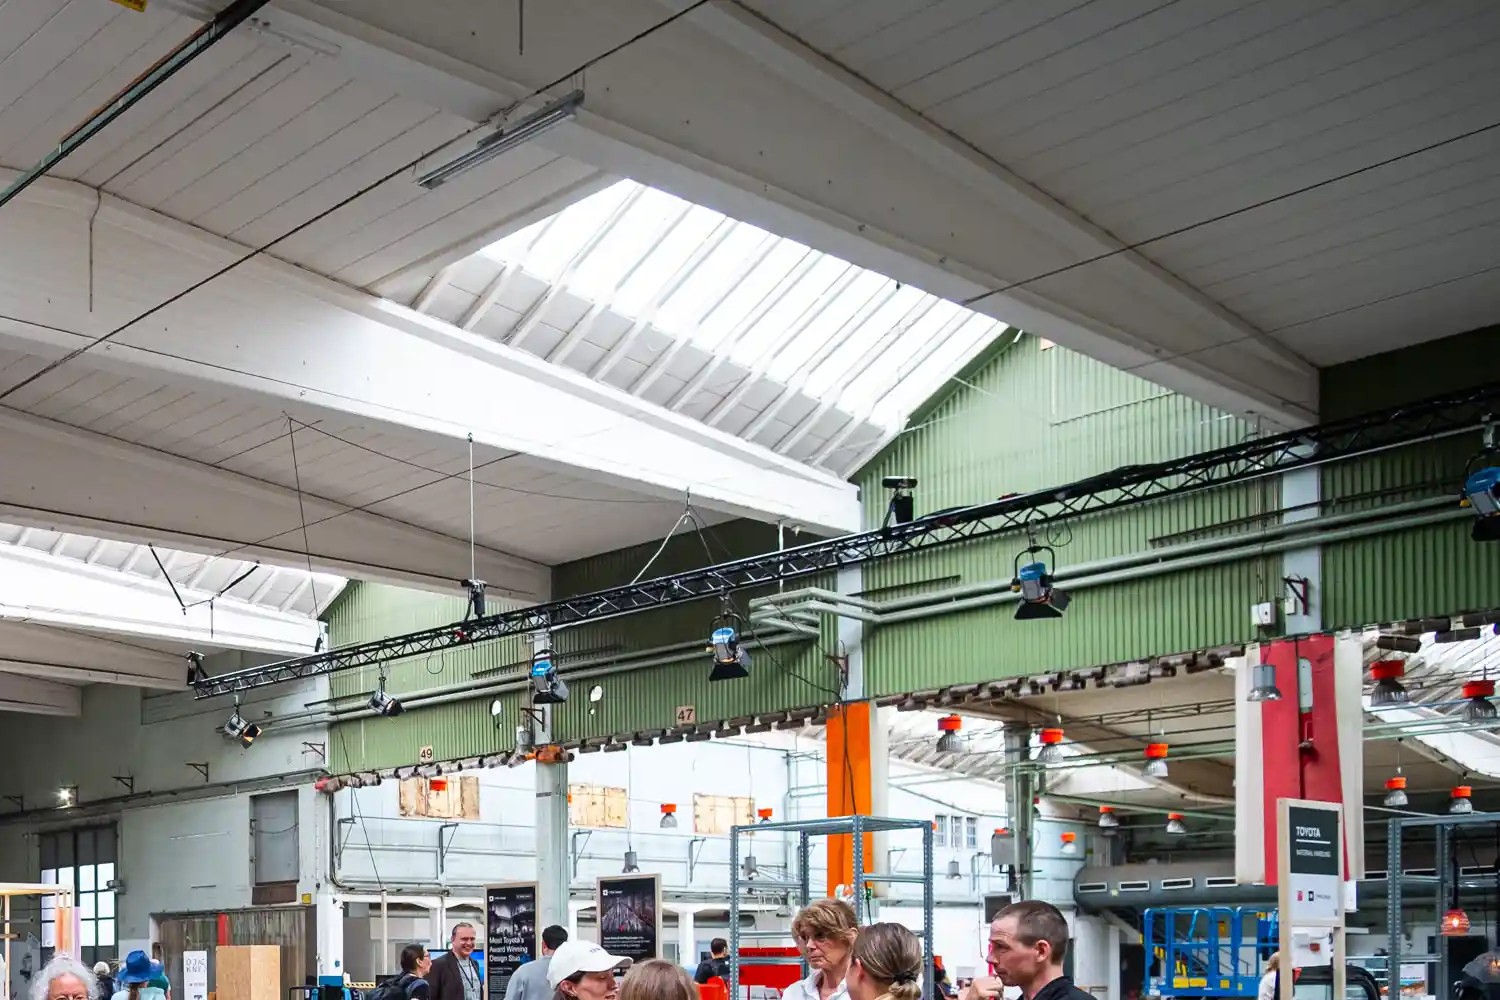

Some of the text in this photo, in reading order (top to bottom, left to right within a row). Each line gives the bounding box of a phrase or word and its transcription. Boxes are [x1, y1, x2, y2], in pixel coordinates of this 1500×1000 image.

[678, 709, 693, 721] 47
[421, 749, 432, 758] 49
[1296, 826, 1321, 837] TOYOTA
[489, 955, 508, 963] Design
